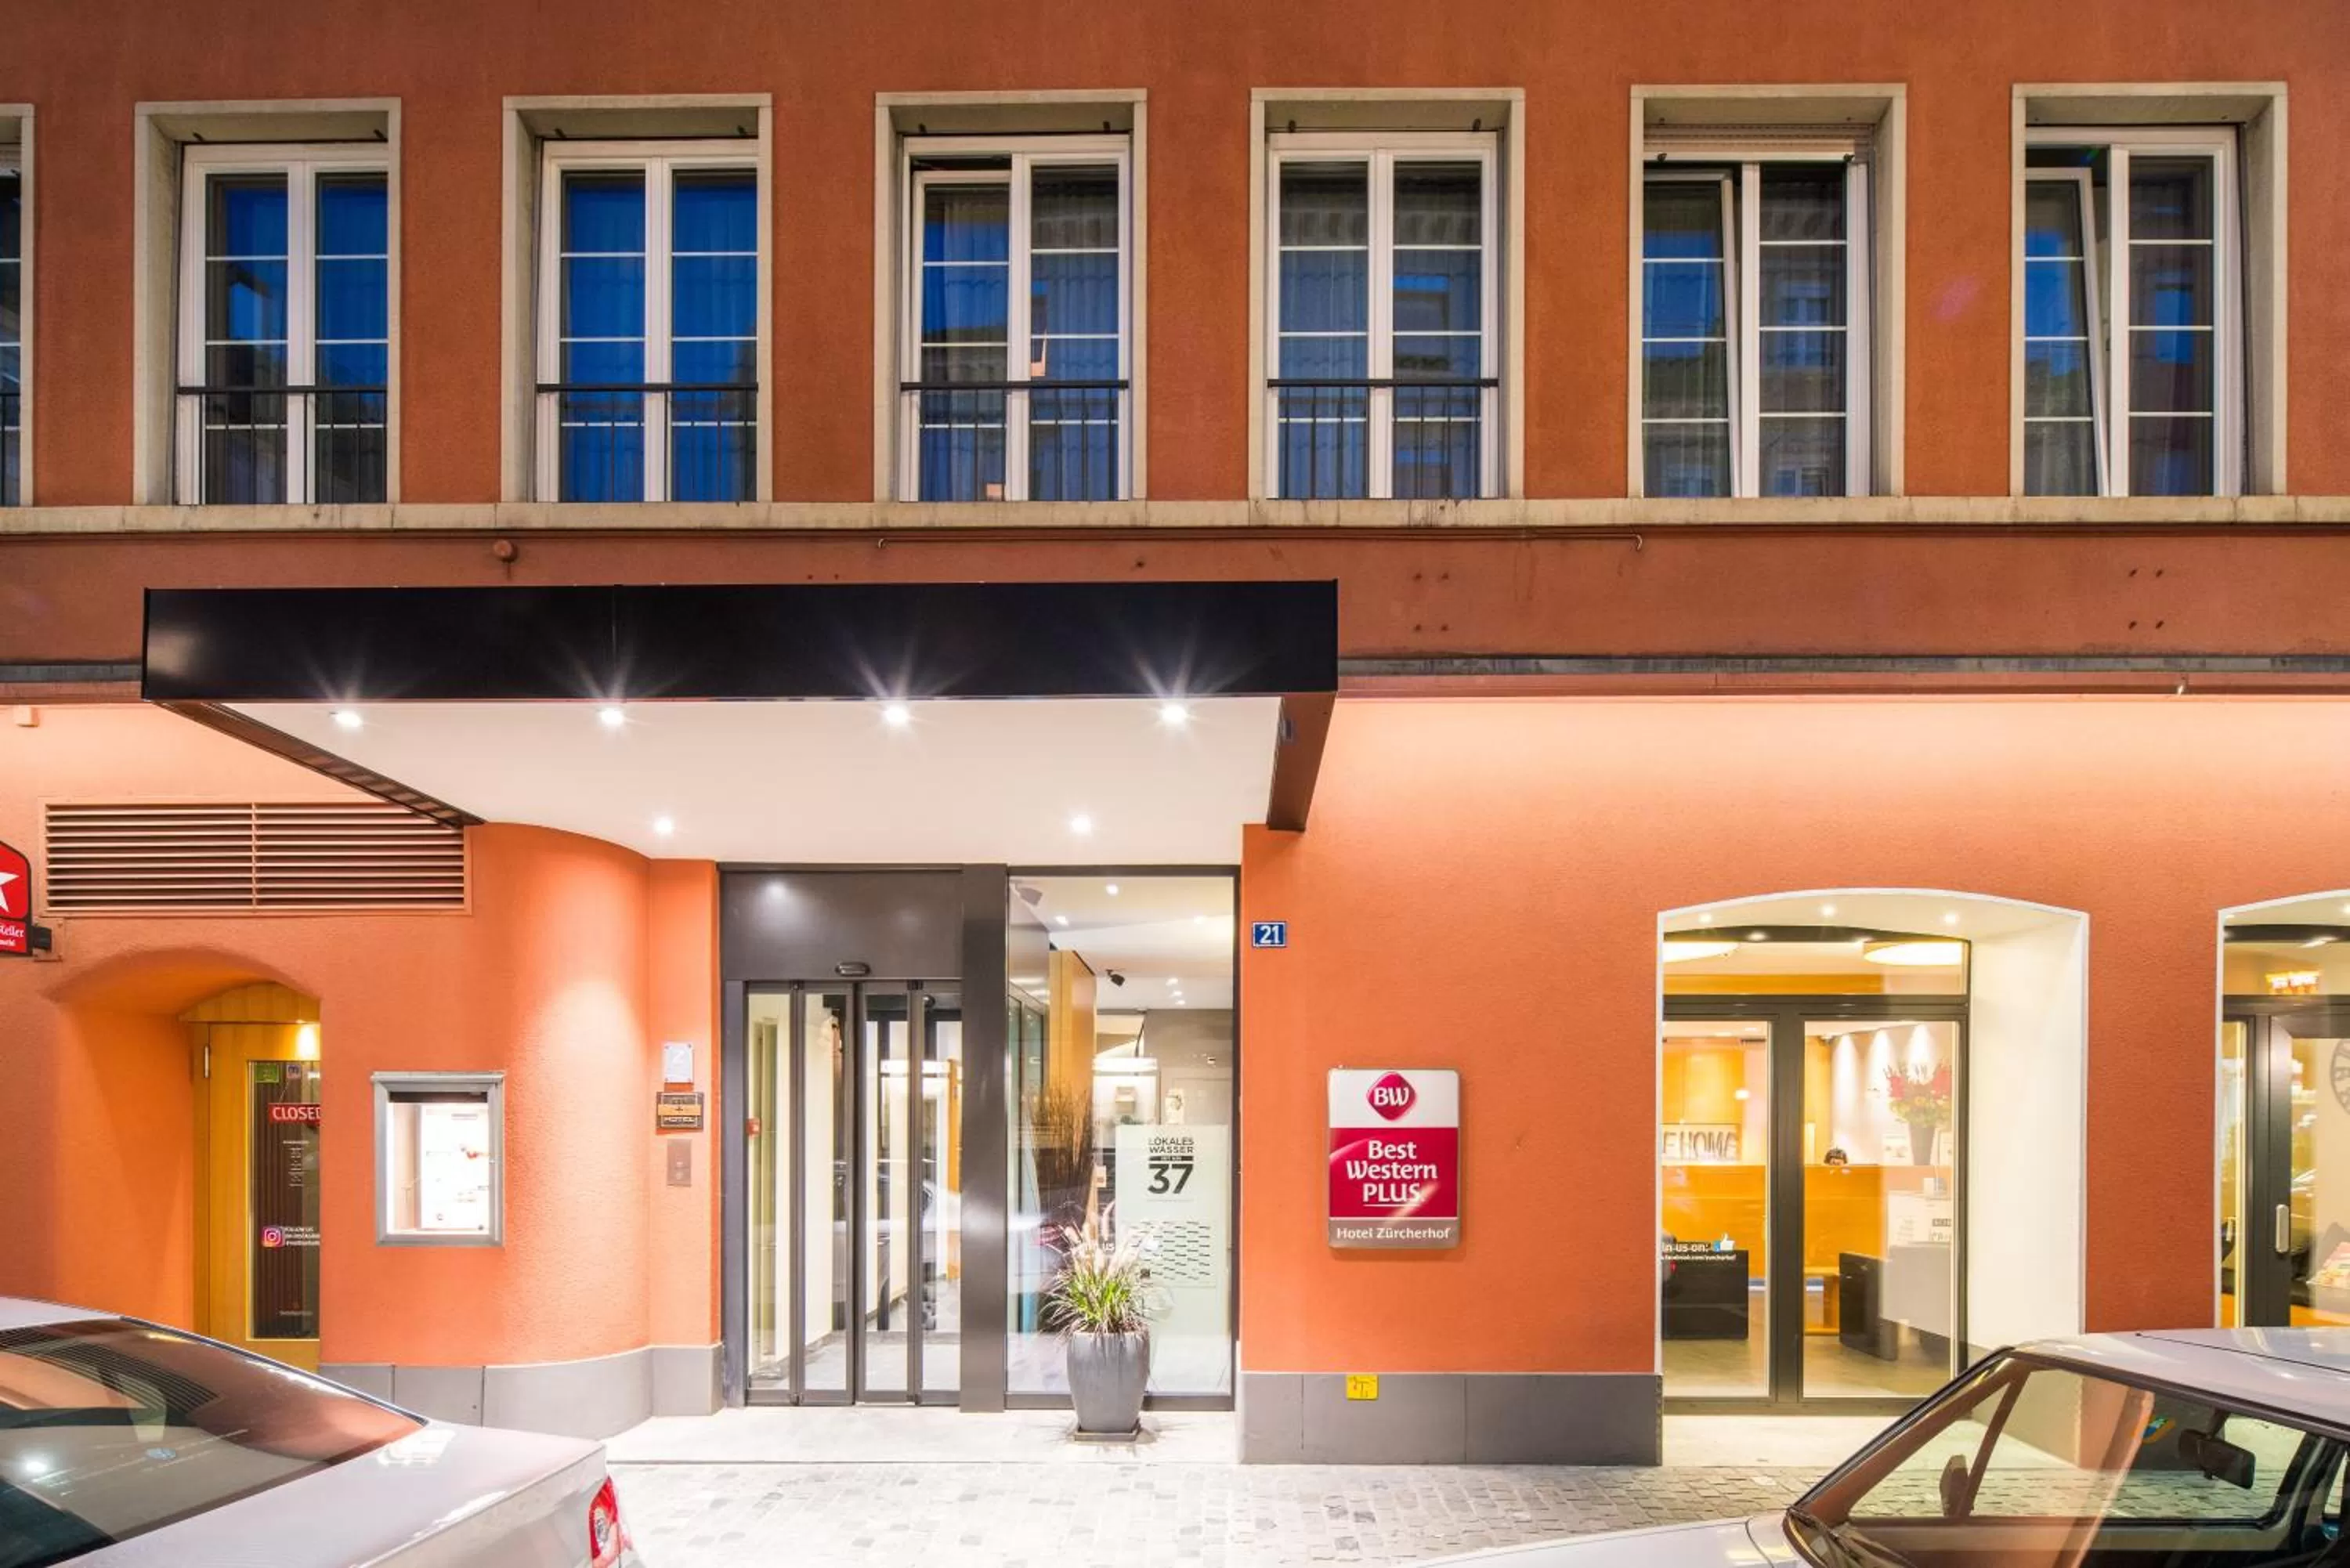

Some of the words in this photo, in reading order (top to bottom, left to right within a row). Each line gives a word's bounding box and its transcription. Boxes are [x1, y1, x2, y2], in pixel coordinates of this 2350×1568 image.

[1260, 925, 1280, 944] 21
[1373, 1087, 1409, 1106] BW
[1148, 1136, 1195, 1146] LOKALES
[1368, 1140, 1417, 1159] Best
[1148, 1164, 1194, 1194] 37
[1345, 1160, 1438, 1180] Western
[1362, 1183, 1421, 1203] PLUS
[1336, 1227, 1373, 1239] Hotel
[1376, 1227, 1451, 1240] Zürcherhof
